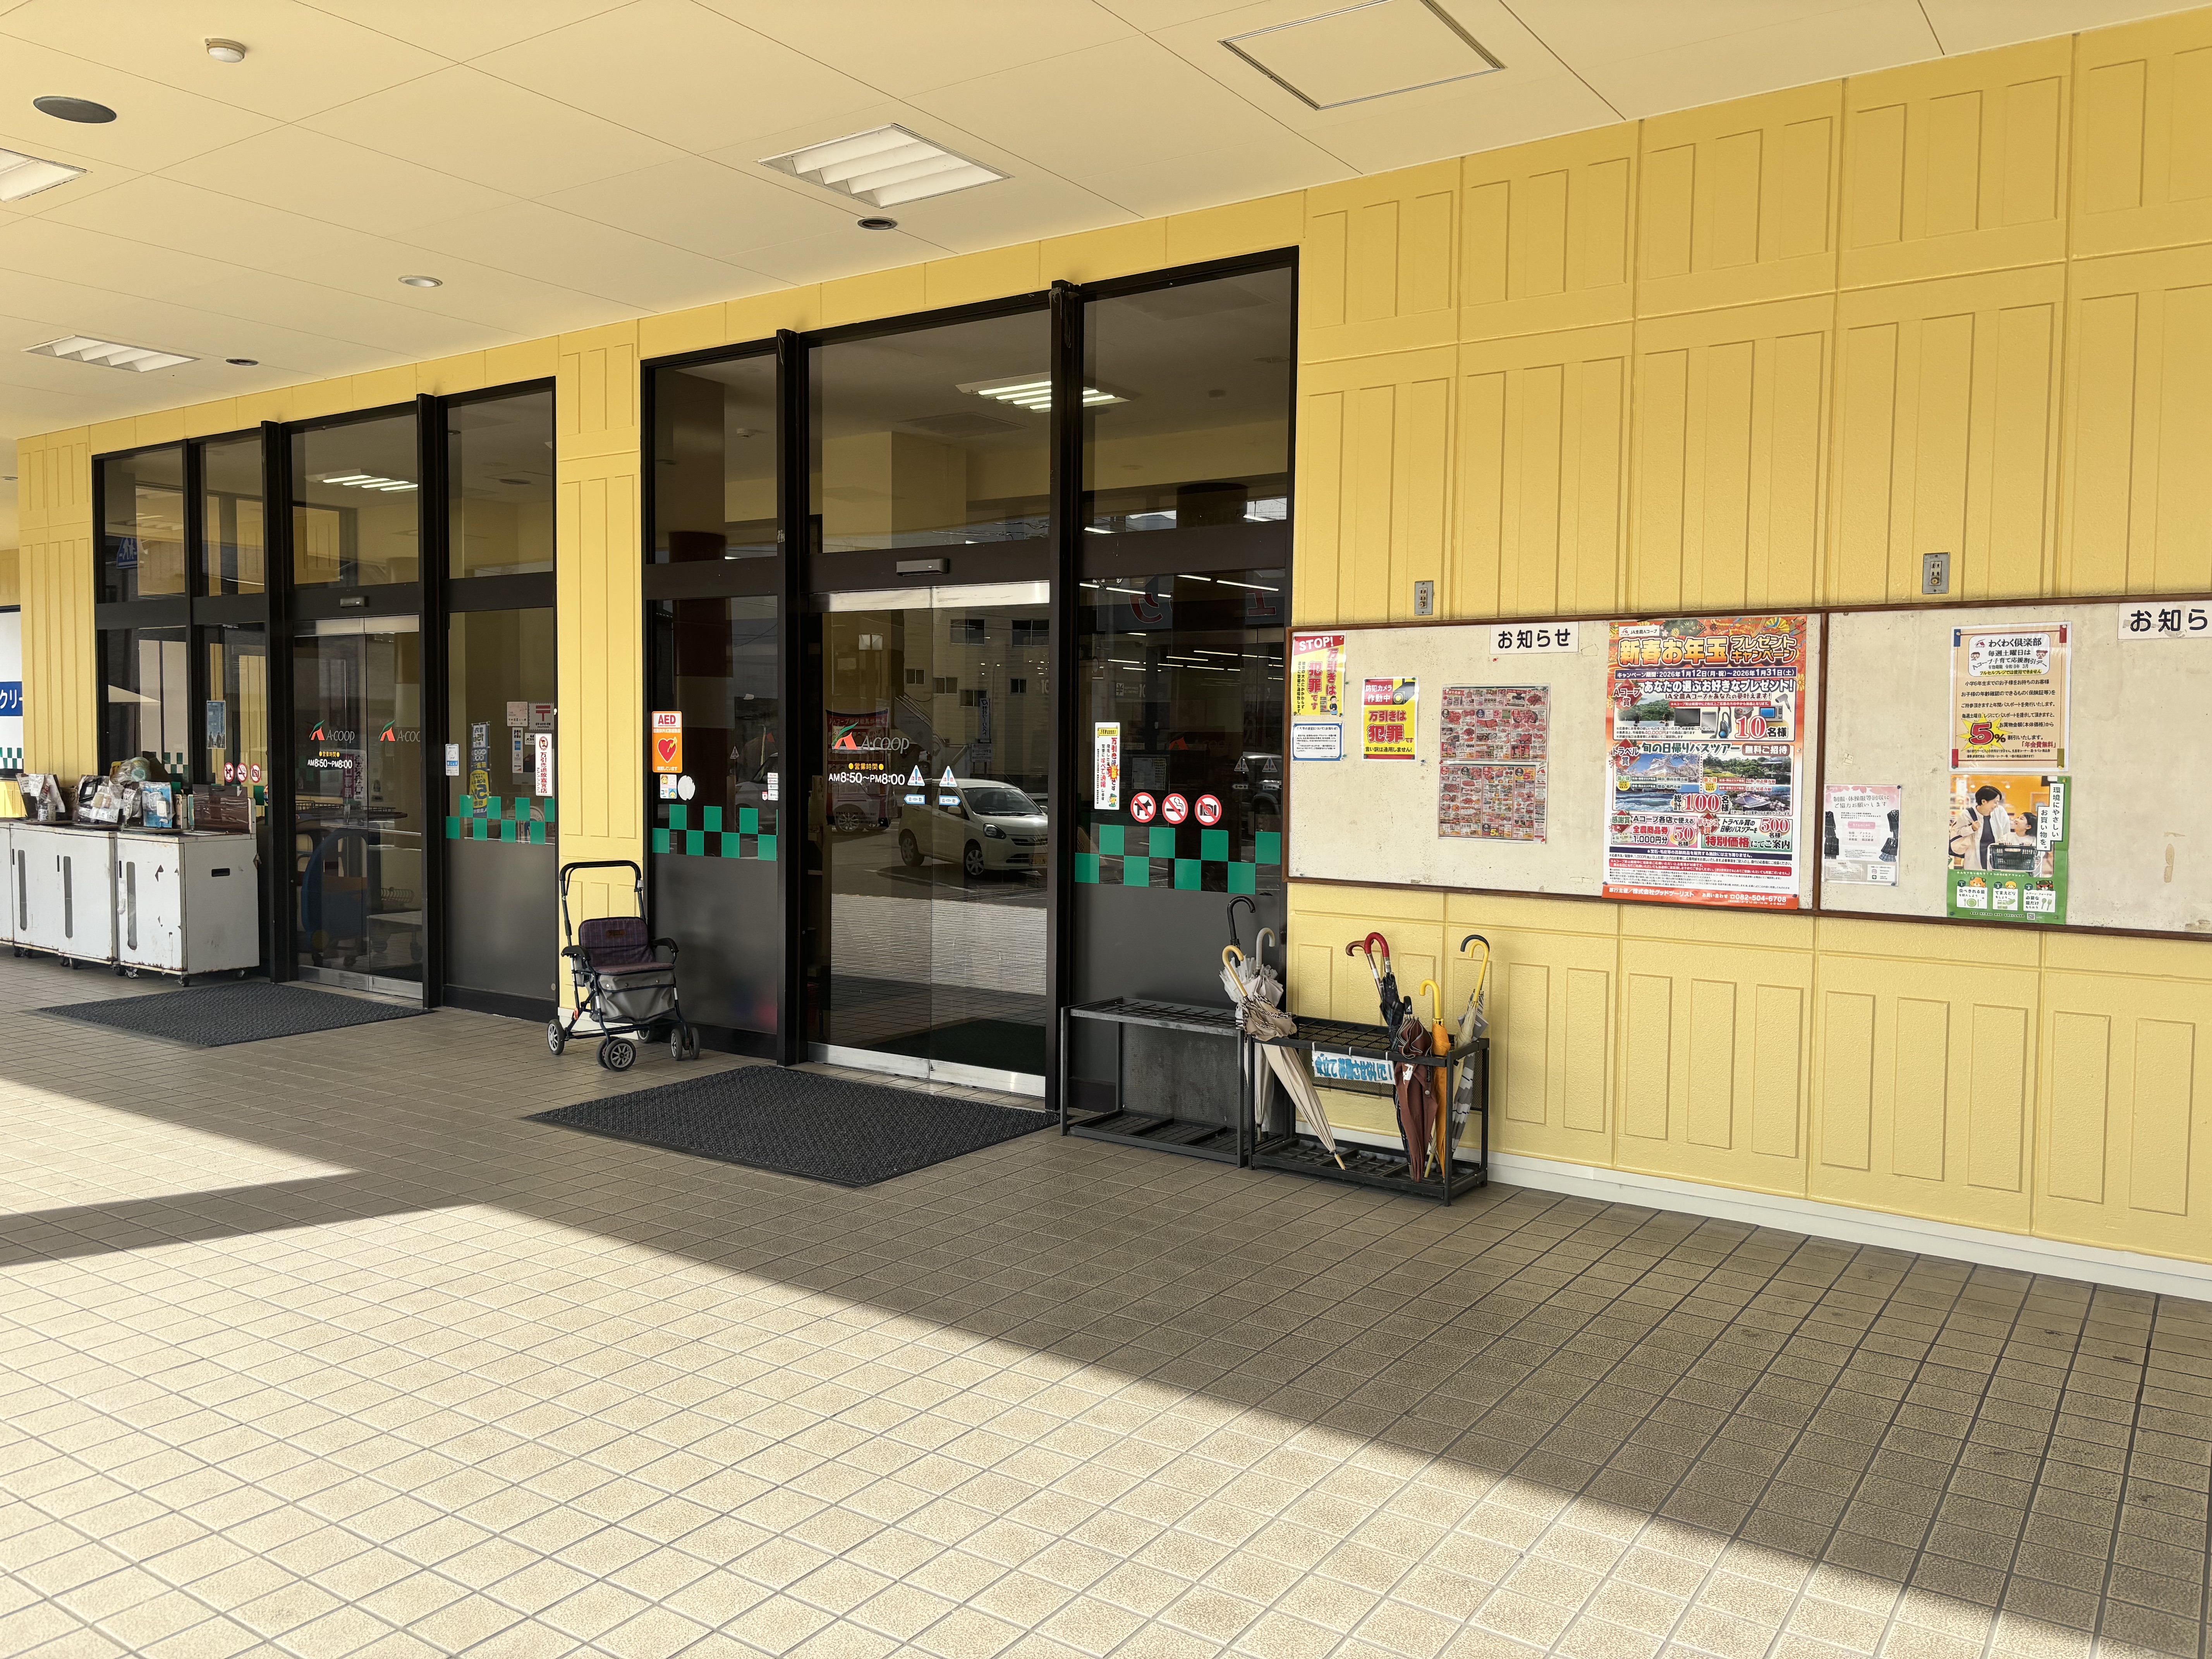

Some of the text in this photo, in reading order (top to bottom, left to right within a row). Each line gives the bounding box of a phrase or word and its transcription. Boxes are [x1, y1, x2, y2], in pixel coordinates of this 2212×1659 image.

[1299, 637, 1334, 651] STOP!
[1498, 629, 1571, 649] お知らせ
[1732, 635, 1796, 649] プレゼント
[1989, 638, 2042, 647] わくわく倶楽部
[1619, 637, 1728, 665] 新春お年玉
[1731, 649, 1794, 663] キャンペーン
[1326, 648, 1339, 696] 万引きは
[1367, 694, 1391, 702] 作動中
[1613, 688, 1641, 697] Aコープ
[1622, 697, 1631, 707] 賞
[658, 714, 676, 725] AED
[1369, 710, 1407, 722] 万引きは
[1613, 747, 1639, 756] トラベル
[1642, 742, 1740, 755] 旬の日帰りバスツアー
[1745, 745, 1788, 754] 無料ご招待
[854, 763, 878, 771] 営業時間
[1622, 757, 1630, 766] 賞
[1683, 793, 1721, 812] 100
[1721, 795, 1729, 812] 名様
[2052, 787, 2061, 837] 環境にやさしい
[1633, 816, 1694, 824] Aコープ各店で使える
[1761, 818, 1790, 832] 500
[1633, 825, 1668, 835] 全農商品券
[1674, 826, 1694, 841] 50
[2040, 809, 2048, 848] お買い物を。
[1633, 835, 1668, 844] 1,000円分
